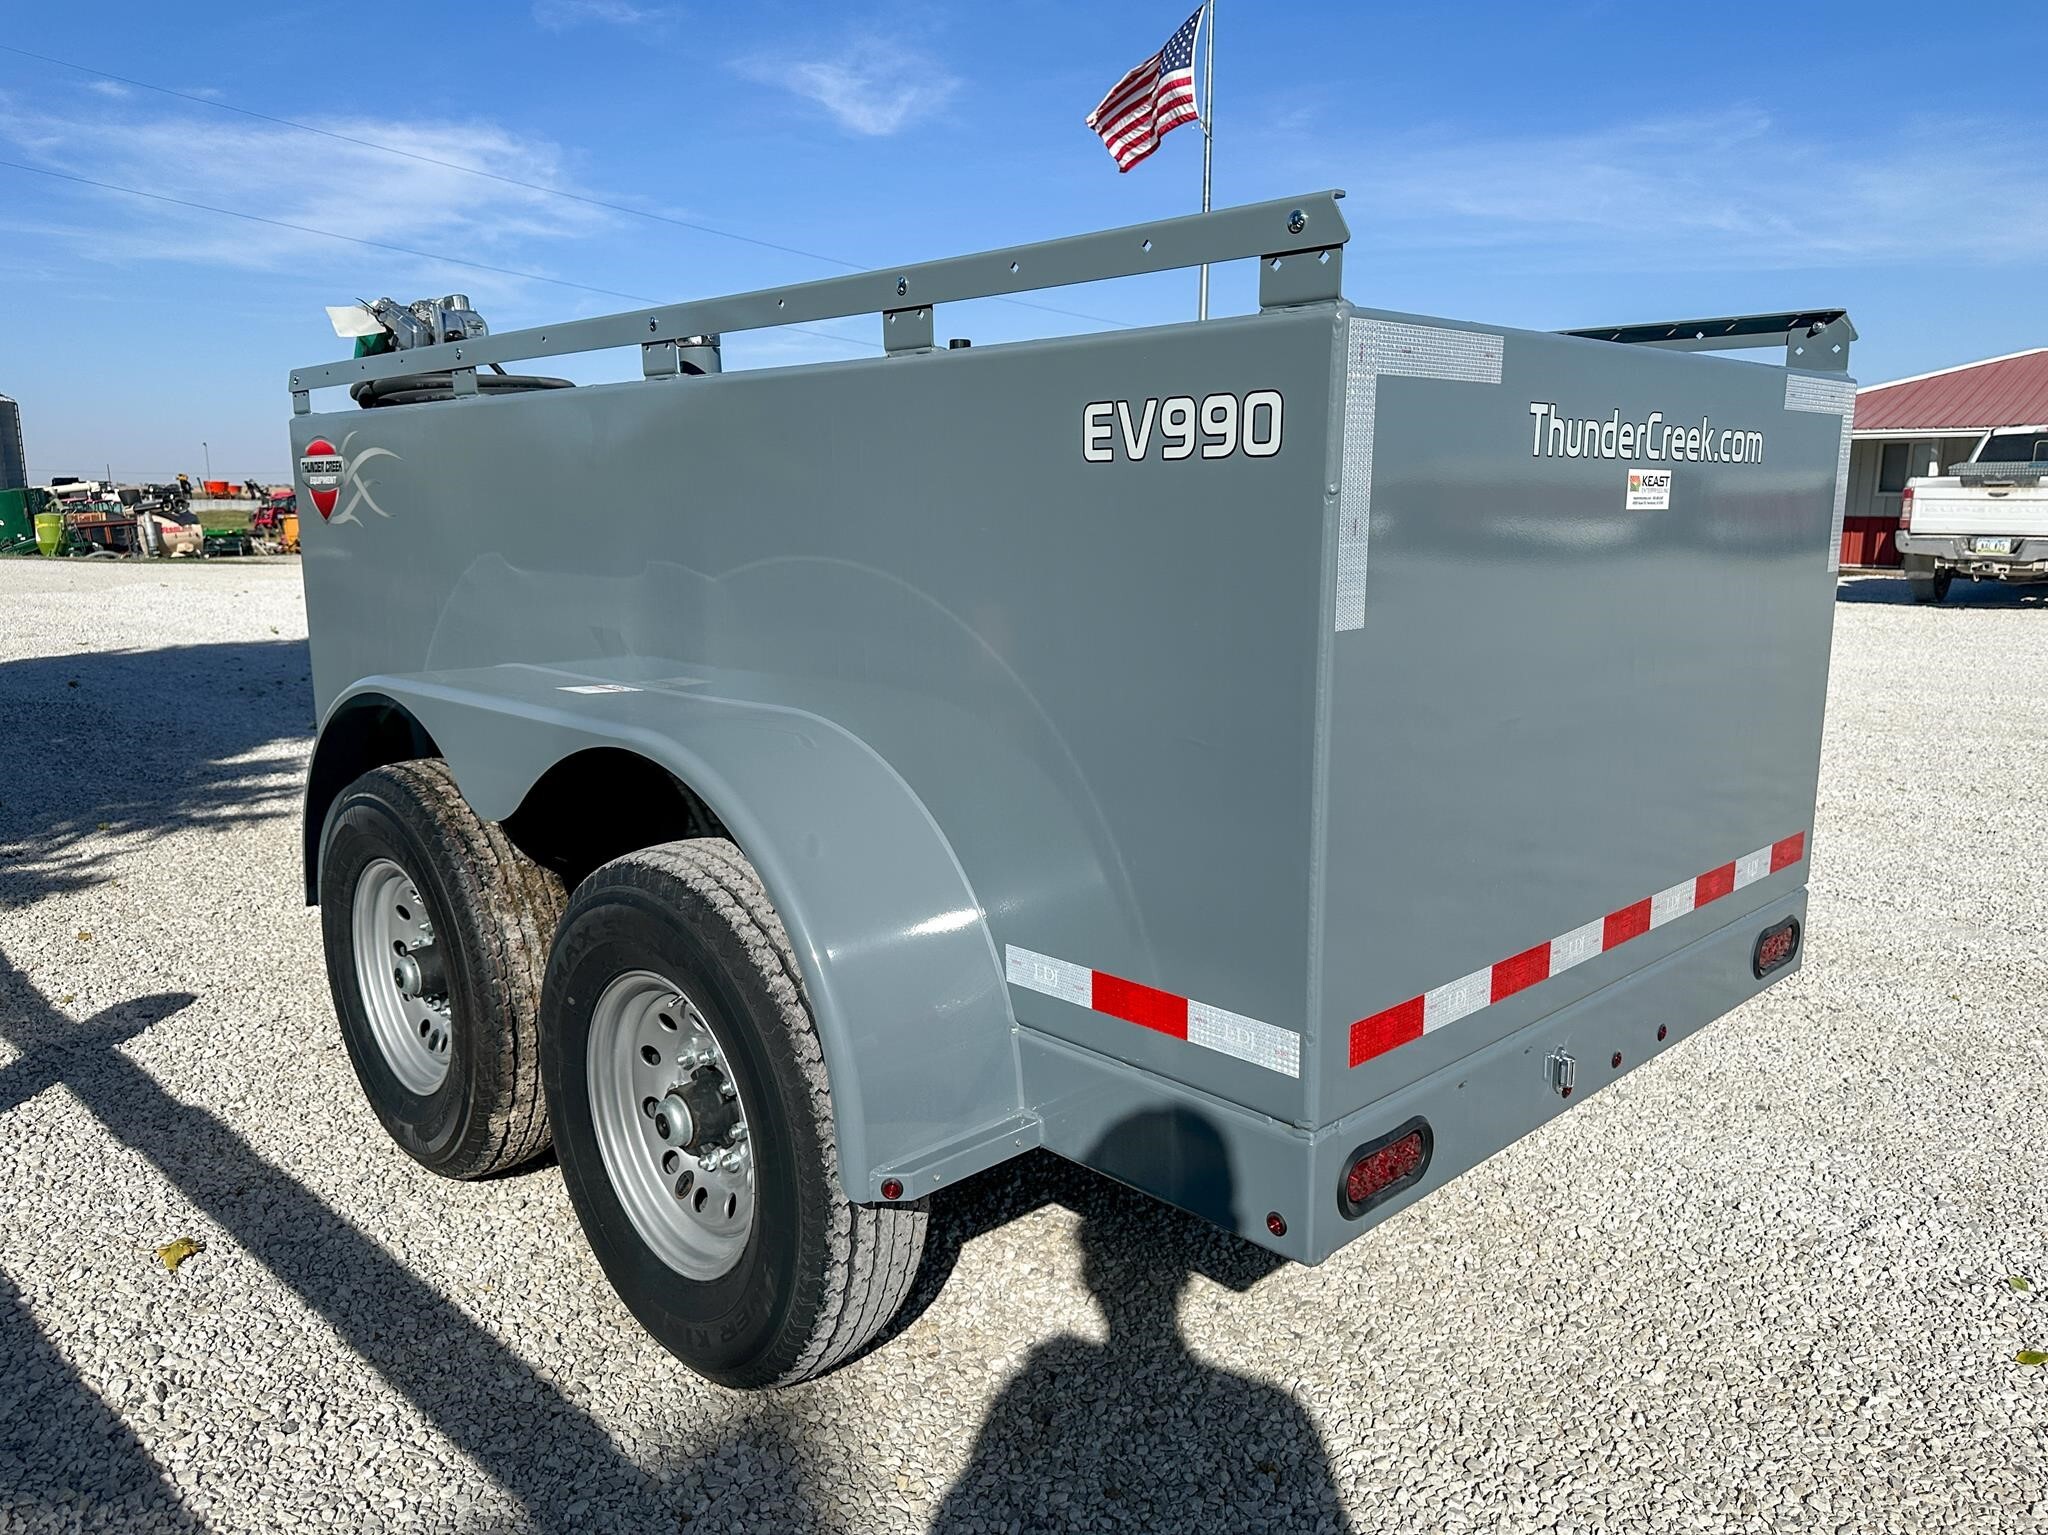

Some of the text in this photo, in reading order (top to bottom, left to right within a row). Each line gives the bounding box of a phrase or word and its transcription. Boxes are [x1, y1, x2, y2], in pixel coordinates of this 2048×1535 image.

[1083, 389, 1284, 463] EV990
[1529, 401, 1764, 464] ThunderCreek.com
[301, 460, 343, 473] THUNDER CREEK
[1641, 475, 1670, 487] KEAST
